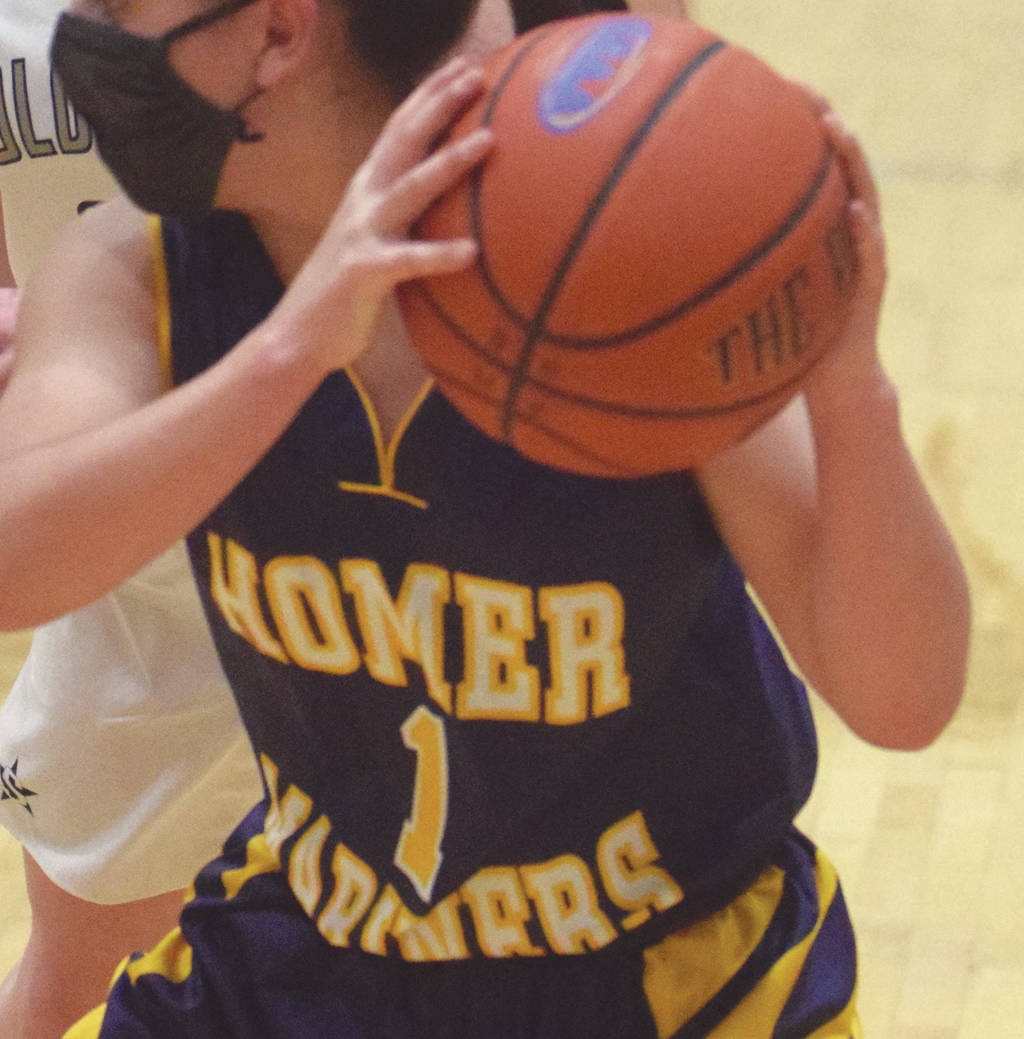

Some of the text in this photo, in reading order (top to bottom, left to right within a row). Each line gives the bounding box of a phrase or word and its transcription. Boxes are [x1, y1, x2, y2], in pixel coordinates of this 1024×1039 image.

[706, 264, 811, 388] THE
[207, 530, 632, 727] HOMER
[393, 704, 449, 905] 1
